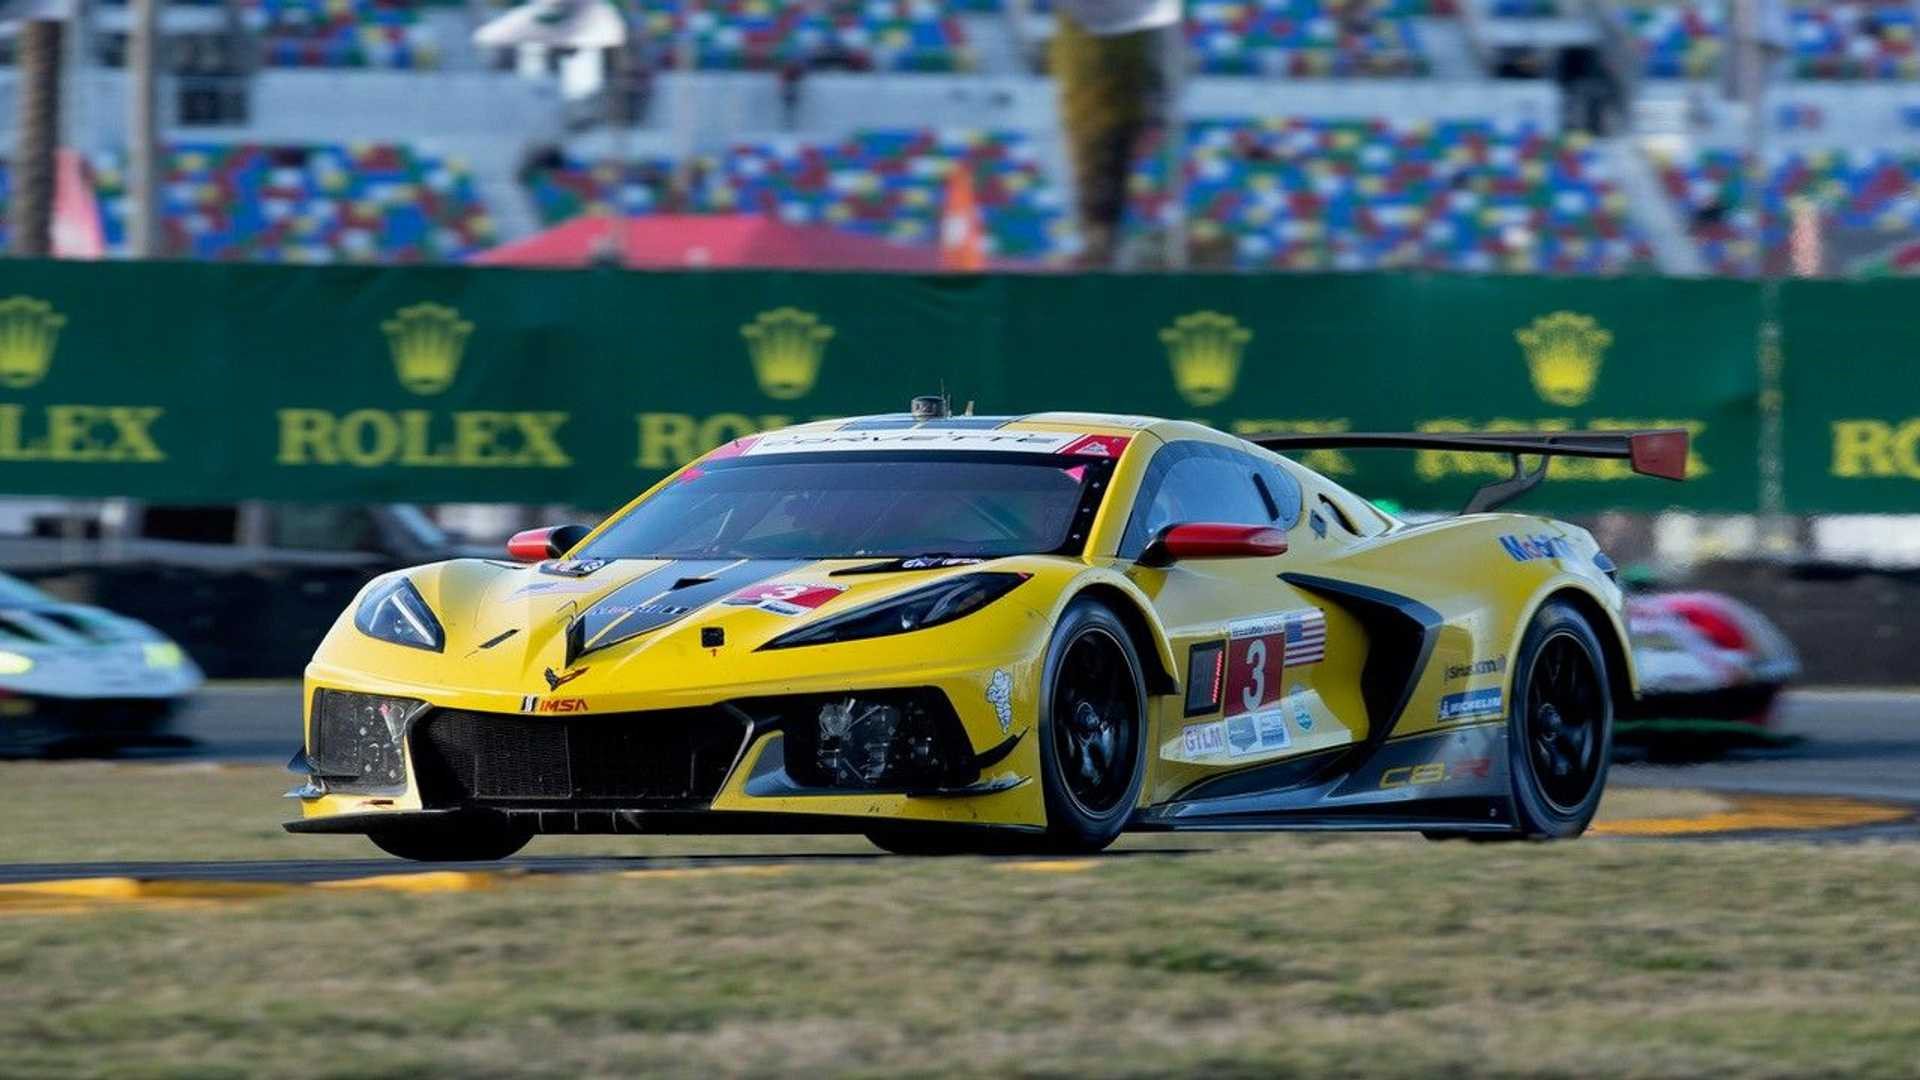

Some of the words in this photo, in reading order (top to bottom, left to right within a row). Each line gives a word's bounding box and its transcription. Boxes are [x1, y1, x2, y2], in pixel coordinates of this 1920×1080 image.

[277, 408, 571, 467] ROLEX
[761, 585, 808, 599] 3
[1243, 639, 1266, 712] 3
[540, 699, 589, 712] IMSA
